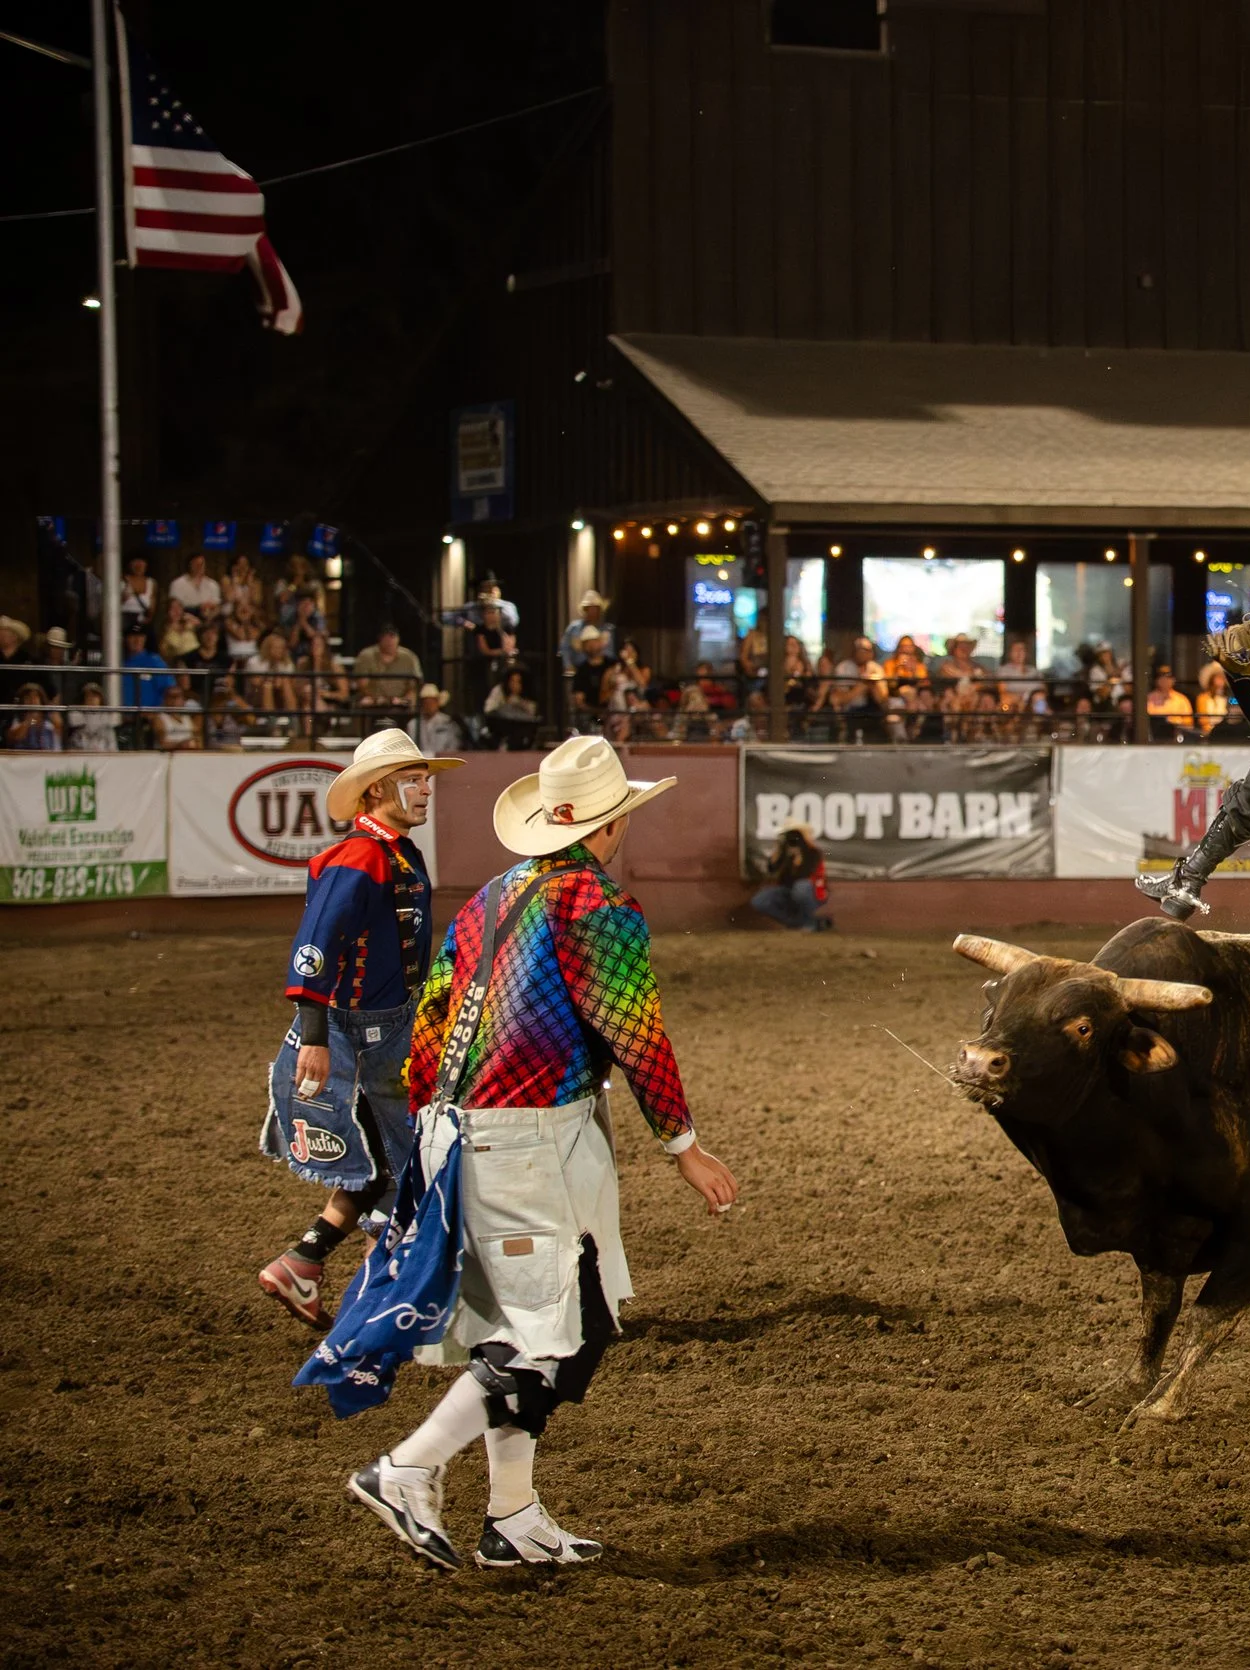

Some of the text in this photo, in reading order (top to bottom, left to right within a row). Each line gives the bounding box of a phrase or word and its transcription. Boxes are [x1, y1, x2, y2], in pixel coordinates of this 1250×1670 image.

[359, 815, 394, 840] CINCH
[756, 792, 1034, 840] BOOT BARN
[444, 981, 477, 1072] JUSTIN
[449, 986, 485, 1081] BOOTS
[290, 1120, 343, 1162] Justin
